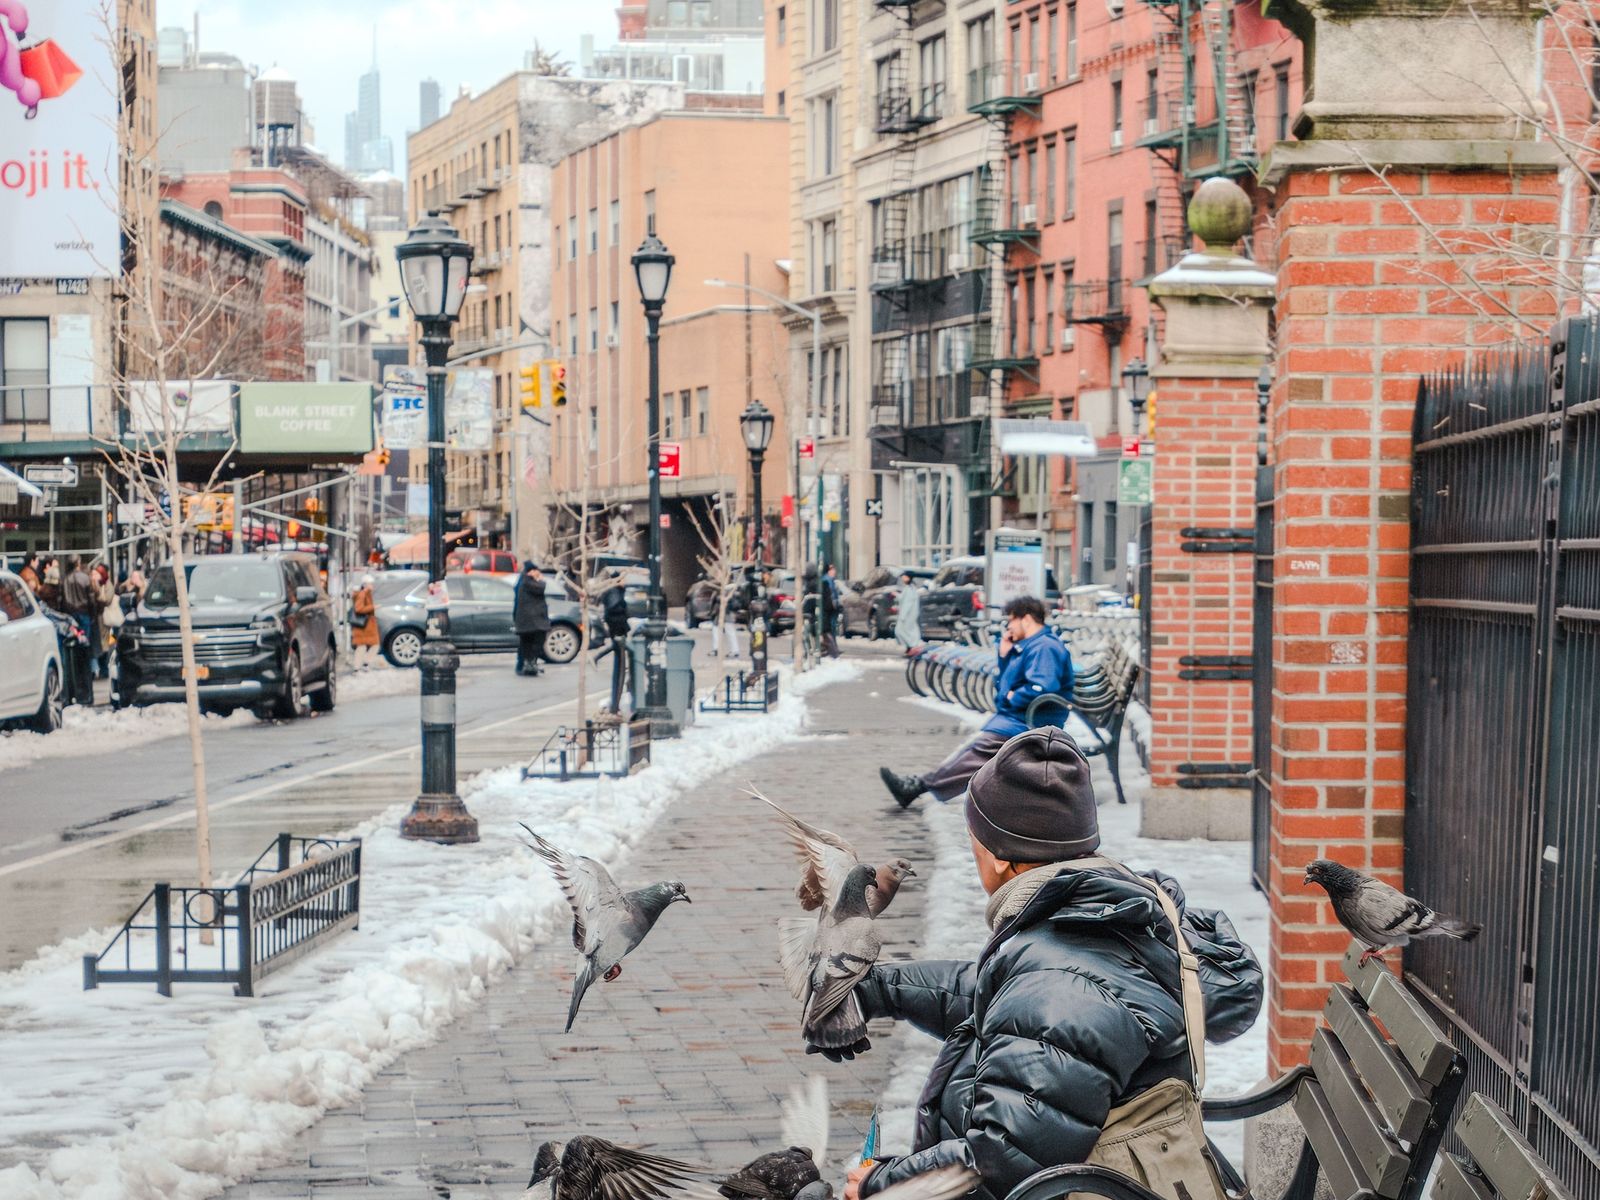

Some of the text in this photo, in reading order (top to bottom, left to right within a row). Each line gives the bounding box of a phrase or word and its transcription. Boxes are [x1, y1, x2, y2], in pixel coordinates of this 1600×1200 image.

[0, 150, 99, 198] oji it.
[54, 240, 95, 250] verizon
[392, 398, 424, 410] FTC
[255, 405, 356, 417] BLANK STREET
[280, 420, 332, 431] COFFEE
